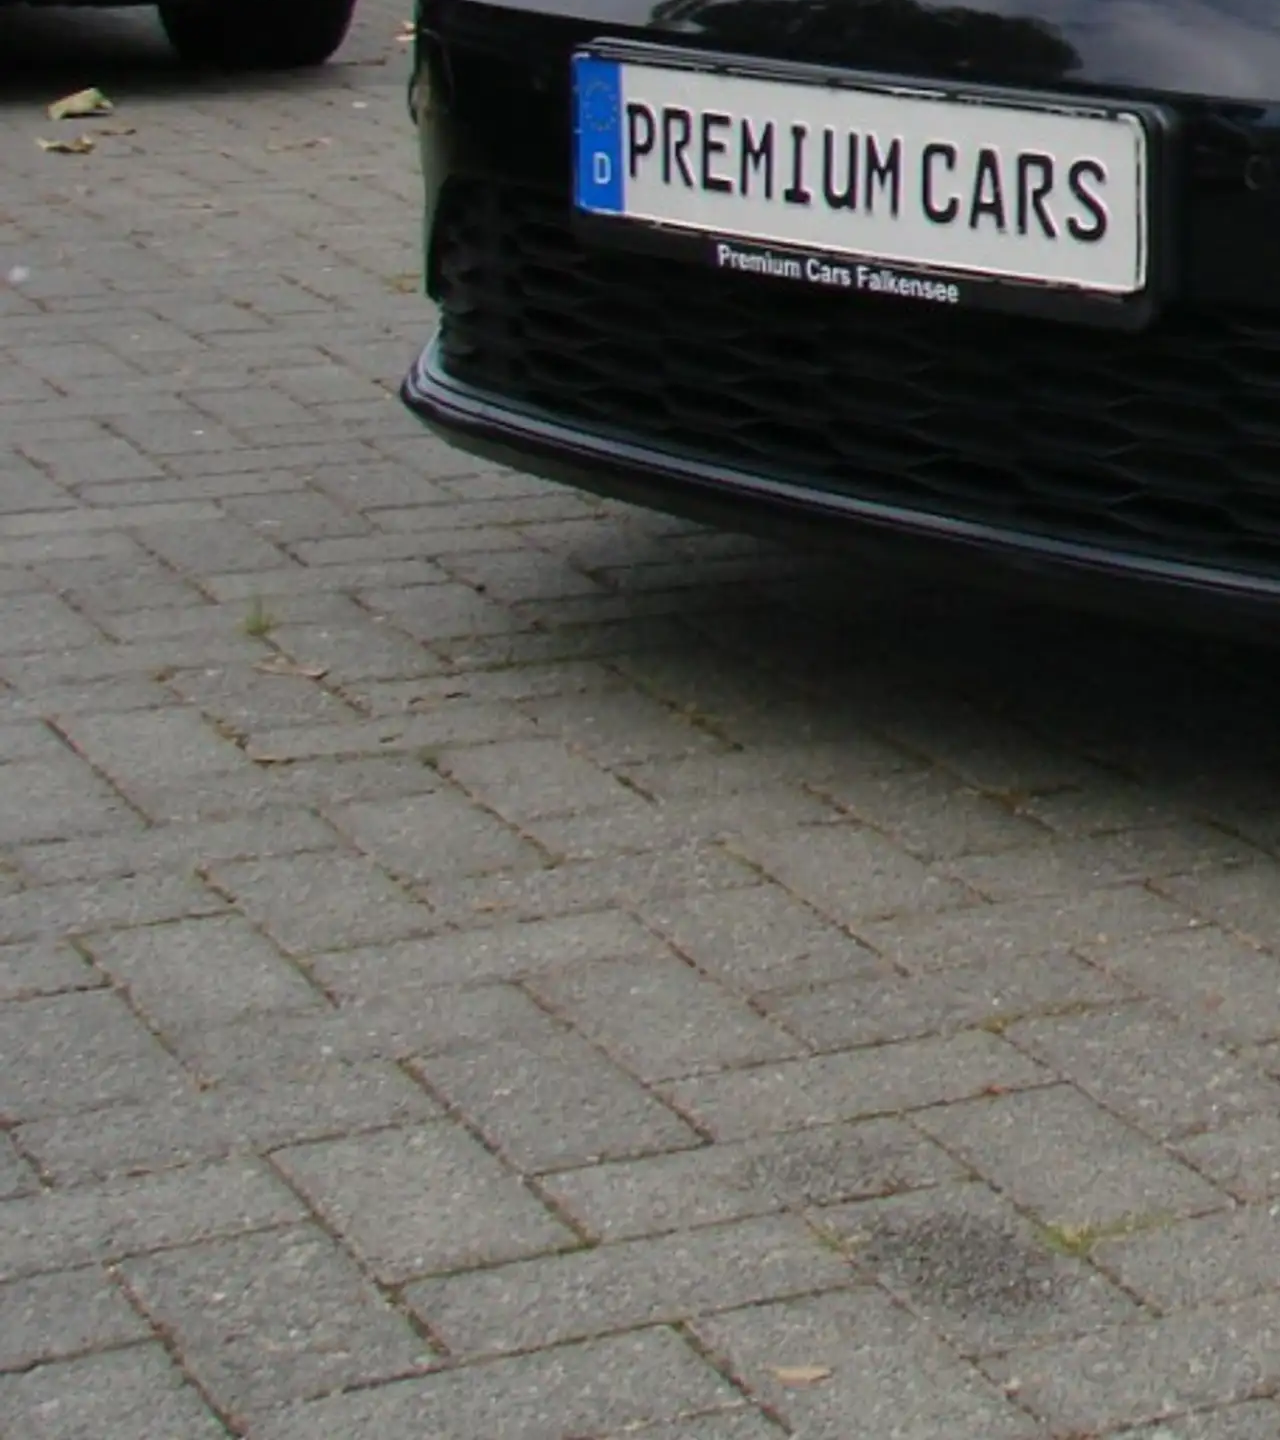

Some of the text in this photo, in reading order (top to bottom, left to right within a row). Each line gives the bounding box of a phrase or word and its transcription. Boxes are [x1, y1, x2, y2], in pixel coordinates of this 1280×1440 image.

[593, 152, 611, 184] D
[627, 102, 1107, 242] PREMIUM CARS
[717, 244, 959, 302] Premium Cars Falkensee
